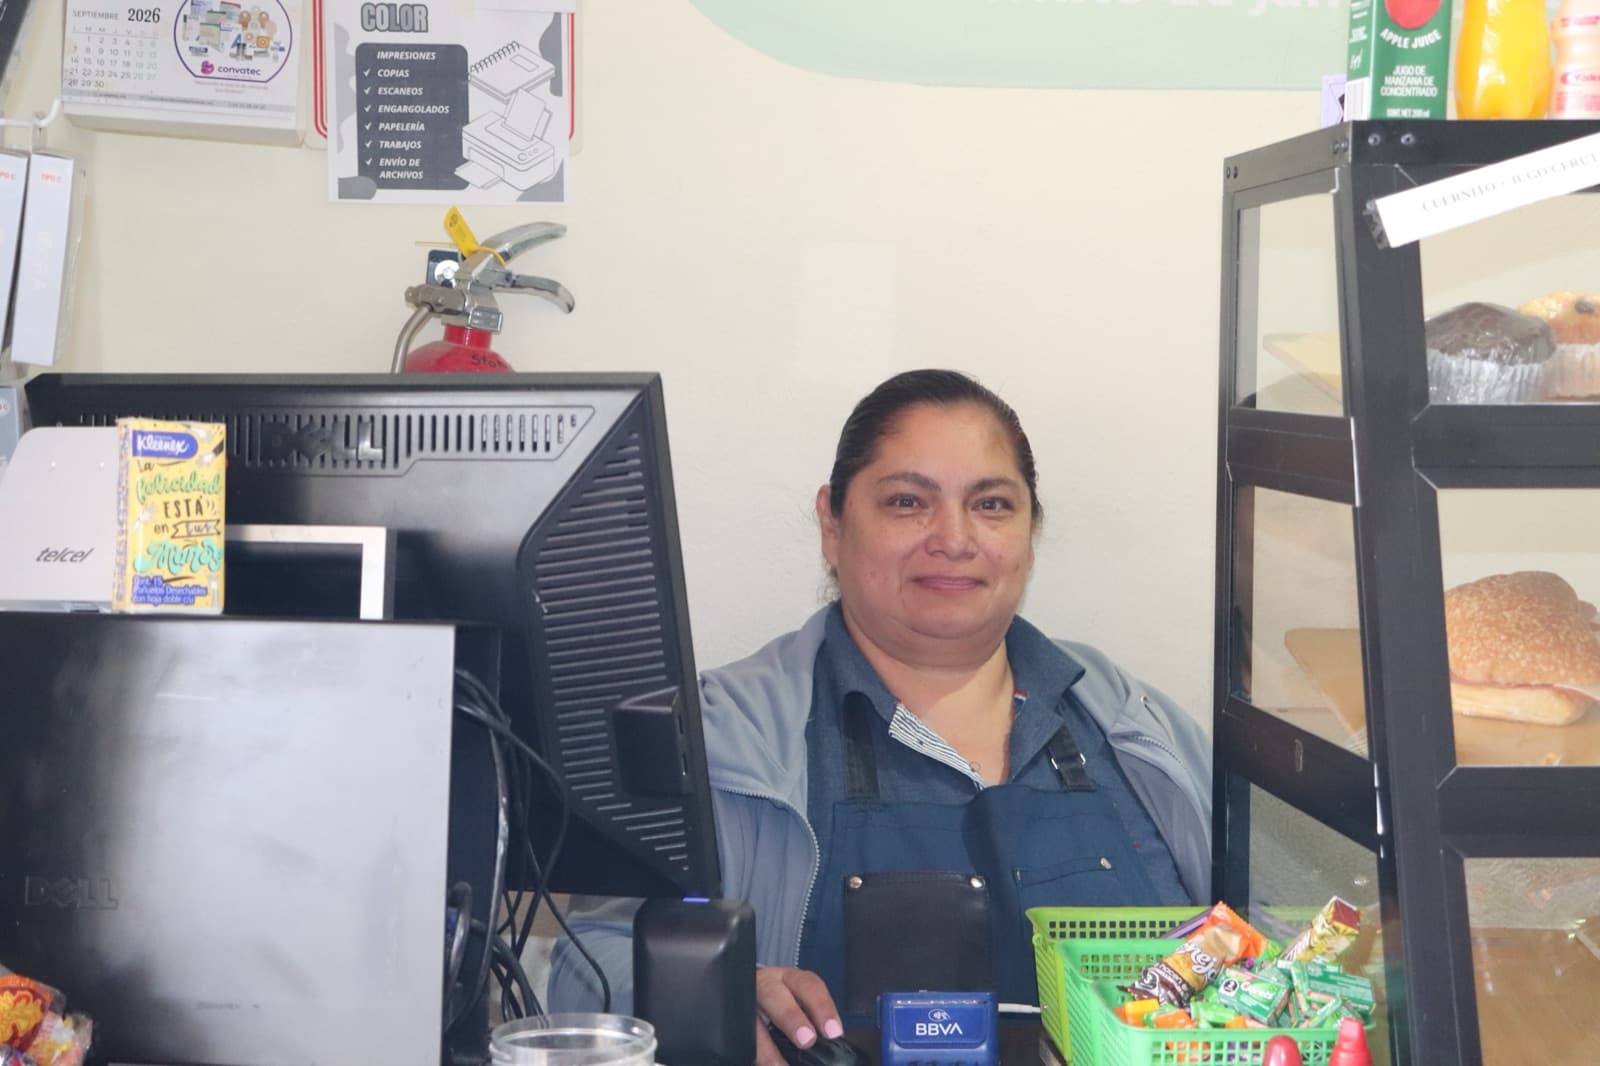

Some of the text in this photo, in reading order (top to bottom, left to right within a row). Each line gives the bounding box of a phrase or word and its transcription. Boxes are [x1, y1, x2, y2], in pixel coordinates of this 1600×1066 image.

[72, 7, 161, 23] SEPTIEMBRE 2026
[361, 2, 429, 33] COLOR
[1380, 28, 1410, 49] APPLE
[1411, 28, 1442, 49] JUICE
[110, 48, 119, 56] 10
[376, 51, 437, 61] IMPRESIONES
[217, 65, 261, 76] convatec
[377, 68, 410, 78] COPIAS
[1393, 65, 1427, 76] JUGO DE
[1384, 75, 1435, 86] MANZANA DE
[377, 86, 424, 96] ESCANEOS
[1380, 86, 1438, 97] CONCENTRADO
[378, 104, 450, 114] ENGARGOLADOS
[378, 120, 425, 132] PAPELERÍA
[379, 140, 422, 150] TRABAJOS
[379, 156, 421, 167] ENVÍO DE
[379, 171, 424, 180] ARCHIVOS
[1421, 182, 1497, 212] CUERNITO
[1511, 166, 1548, 185] JUGO
[136, 433, 190, 455] Kleenex
[163, 495, 204, 518] ESTÁ
[154, 523, 169, 535] en
[36, 547, 96, 562] telcel
[25, 874, 119, 910] DELL
[915, 1022, 963, 1036] BBVA
